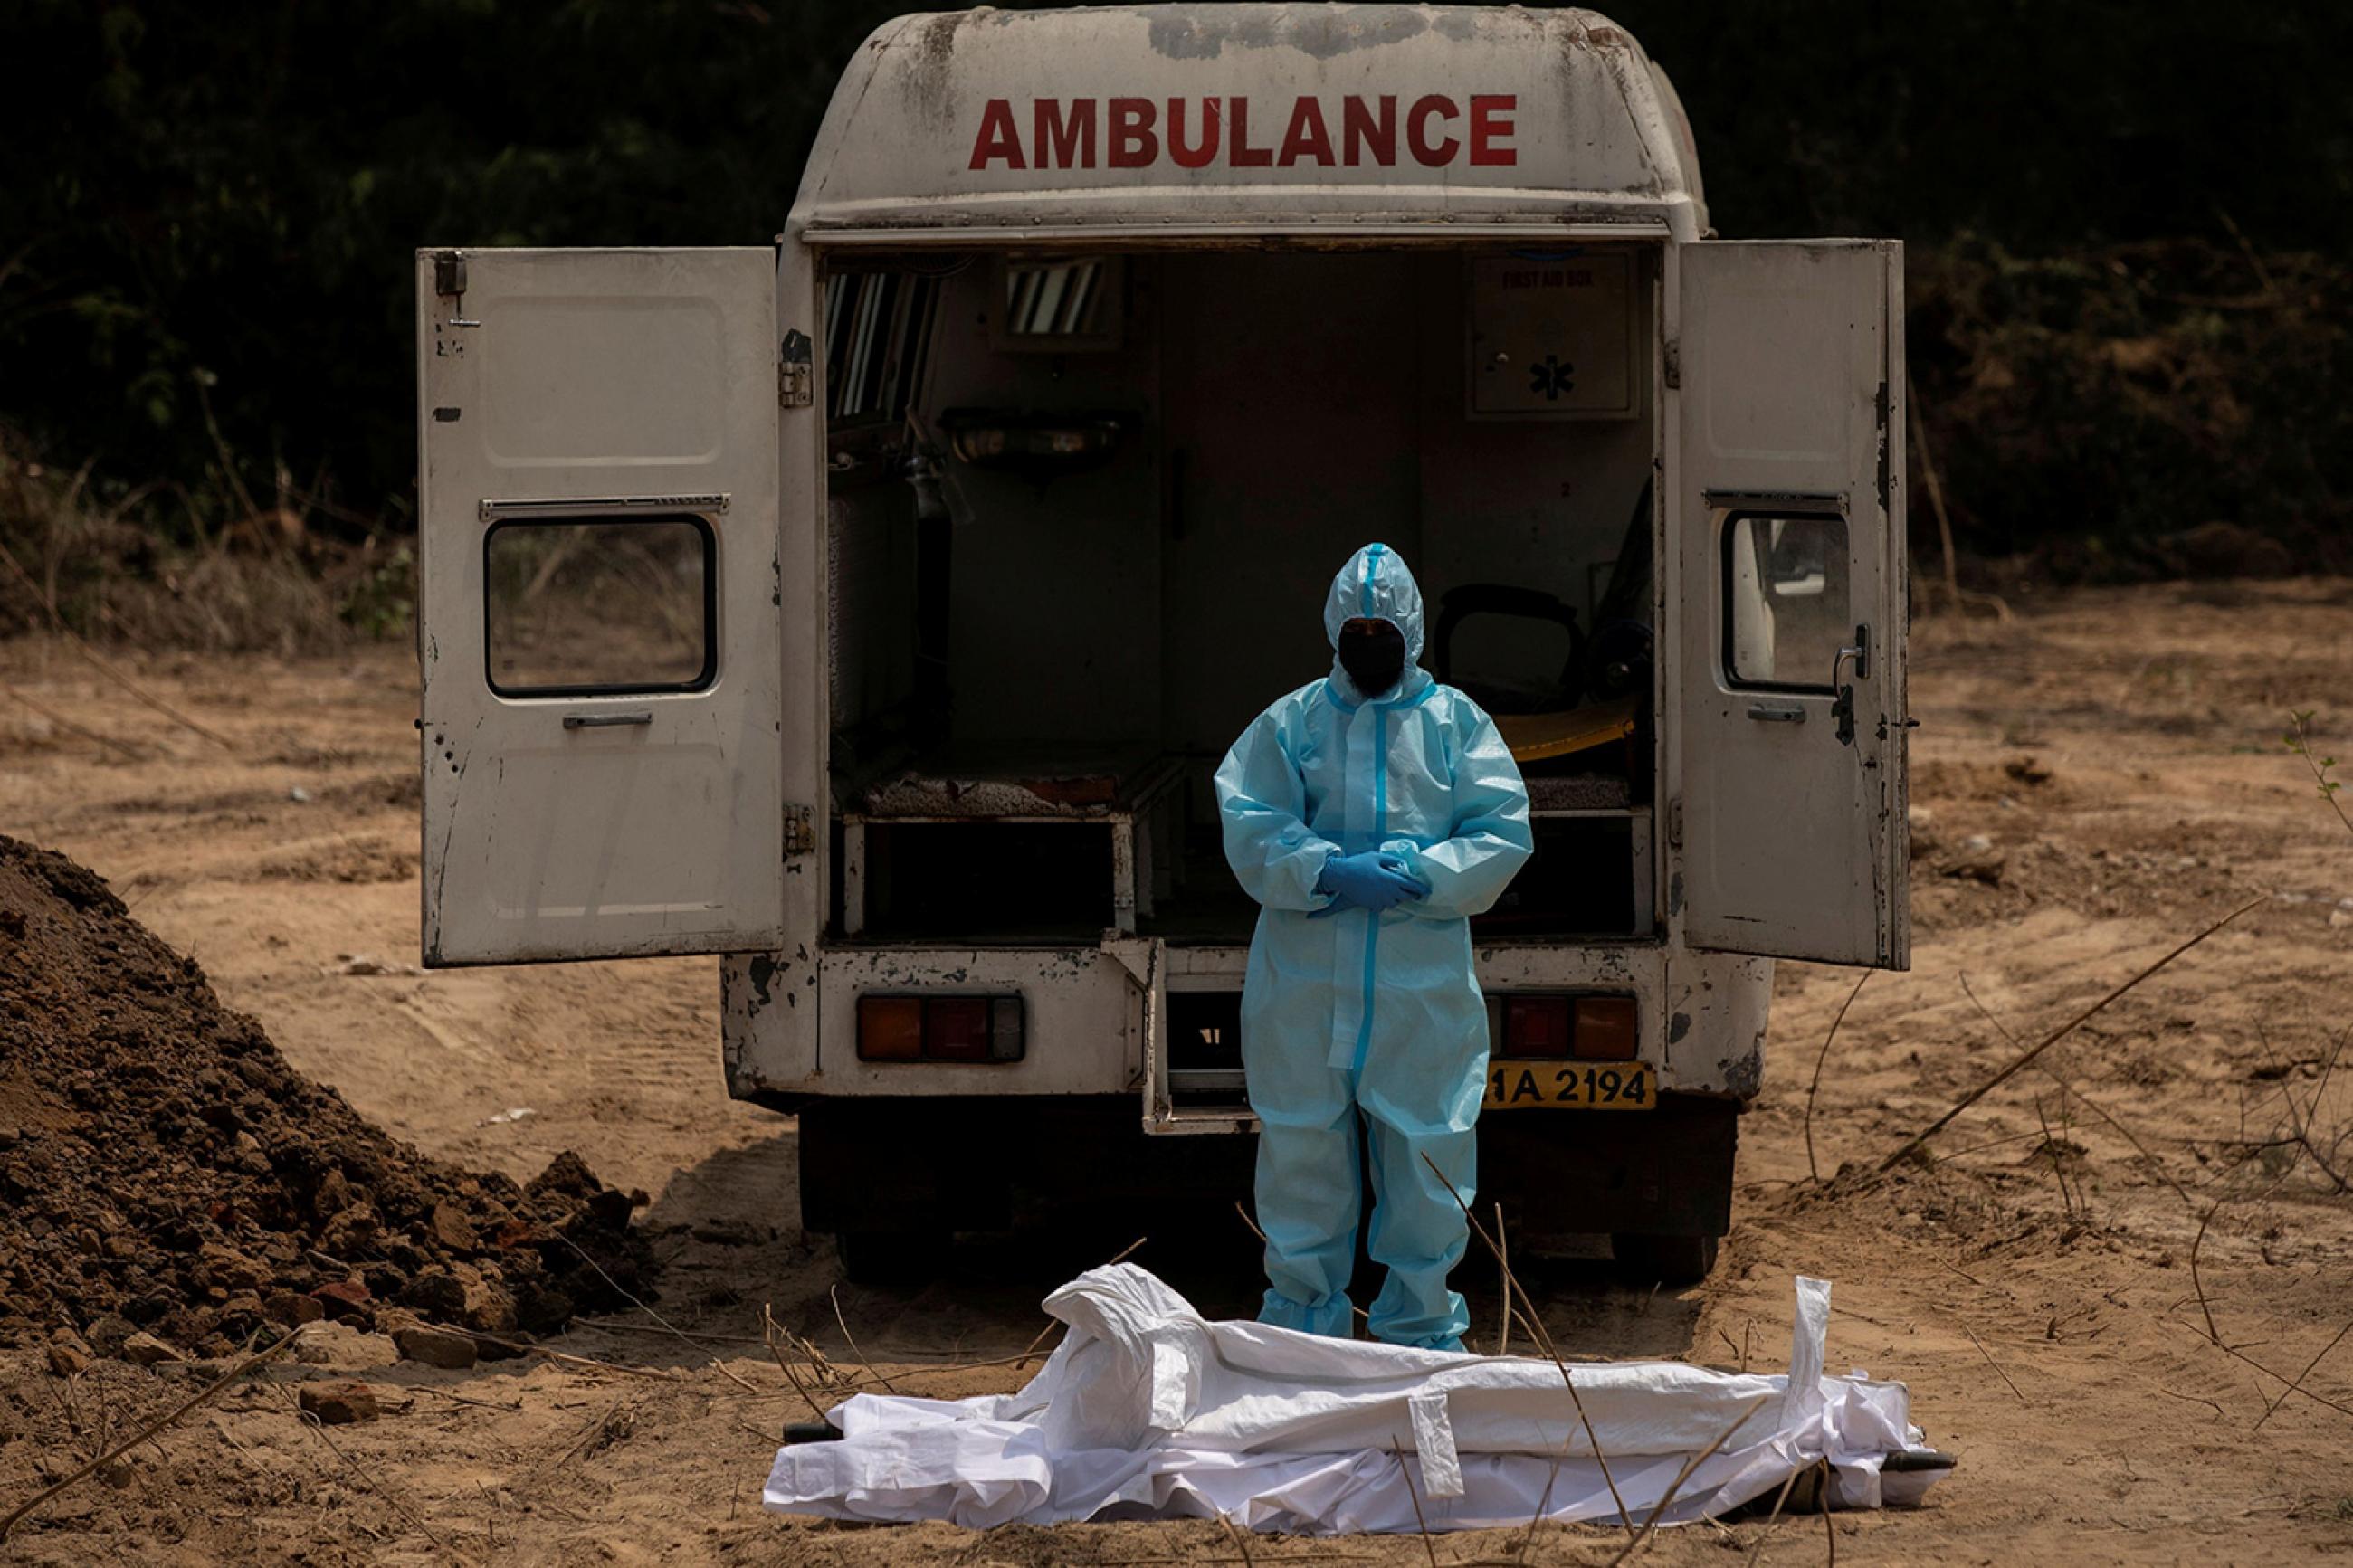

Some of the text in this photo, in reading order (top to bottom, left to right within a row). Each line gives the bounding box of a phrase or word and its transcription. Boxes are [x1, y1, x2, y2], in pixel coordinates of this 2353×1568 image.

[968, 93, 1517, 169] AMBULANCE
[1502, 270, 1595, 290] FIRST AID BOX
[1482, 1069, 1646, 1104] 1A 2194
